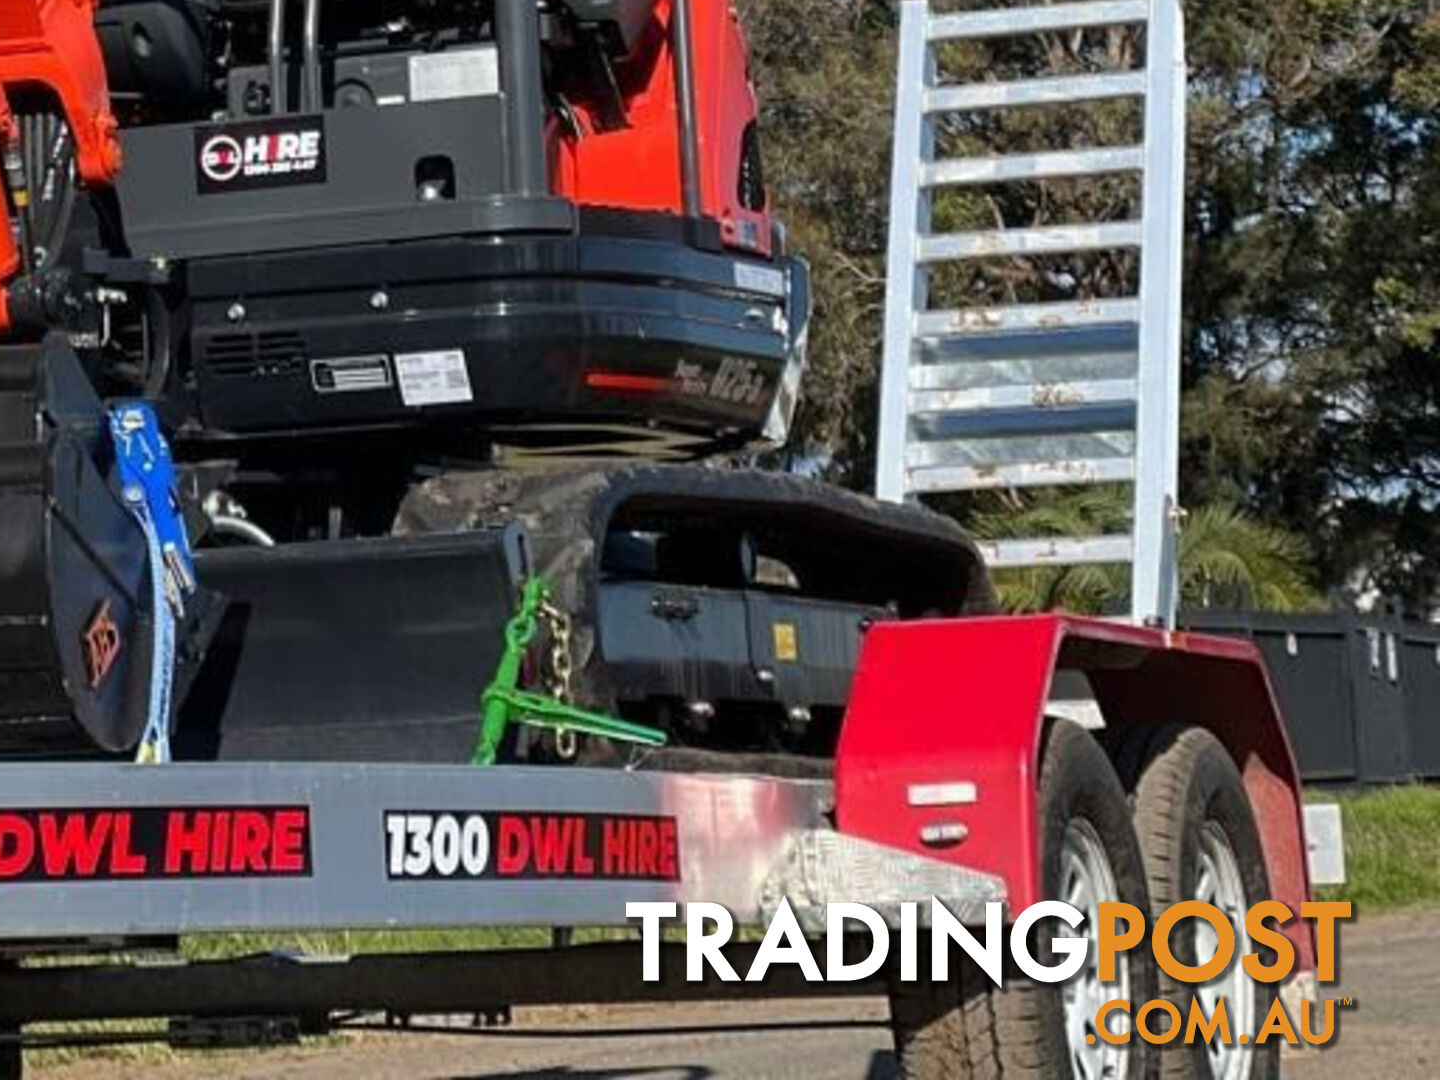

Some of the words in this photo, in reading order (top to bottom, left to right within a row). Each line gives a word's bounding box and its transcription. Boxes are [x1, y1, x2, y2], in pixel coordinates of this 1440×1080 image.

[244, 131, 320, 163] HIRE
[165, 811, 305, 873] HIRE
[387, 815, 490, 876] 1300
[497, 816, 594, 875] DWL
[603, 820, 676, 877] HIRE
